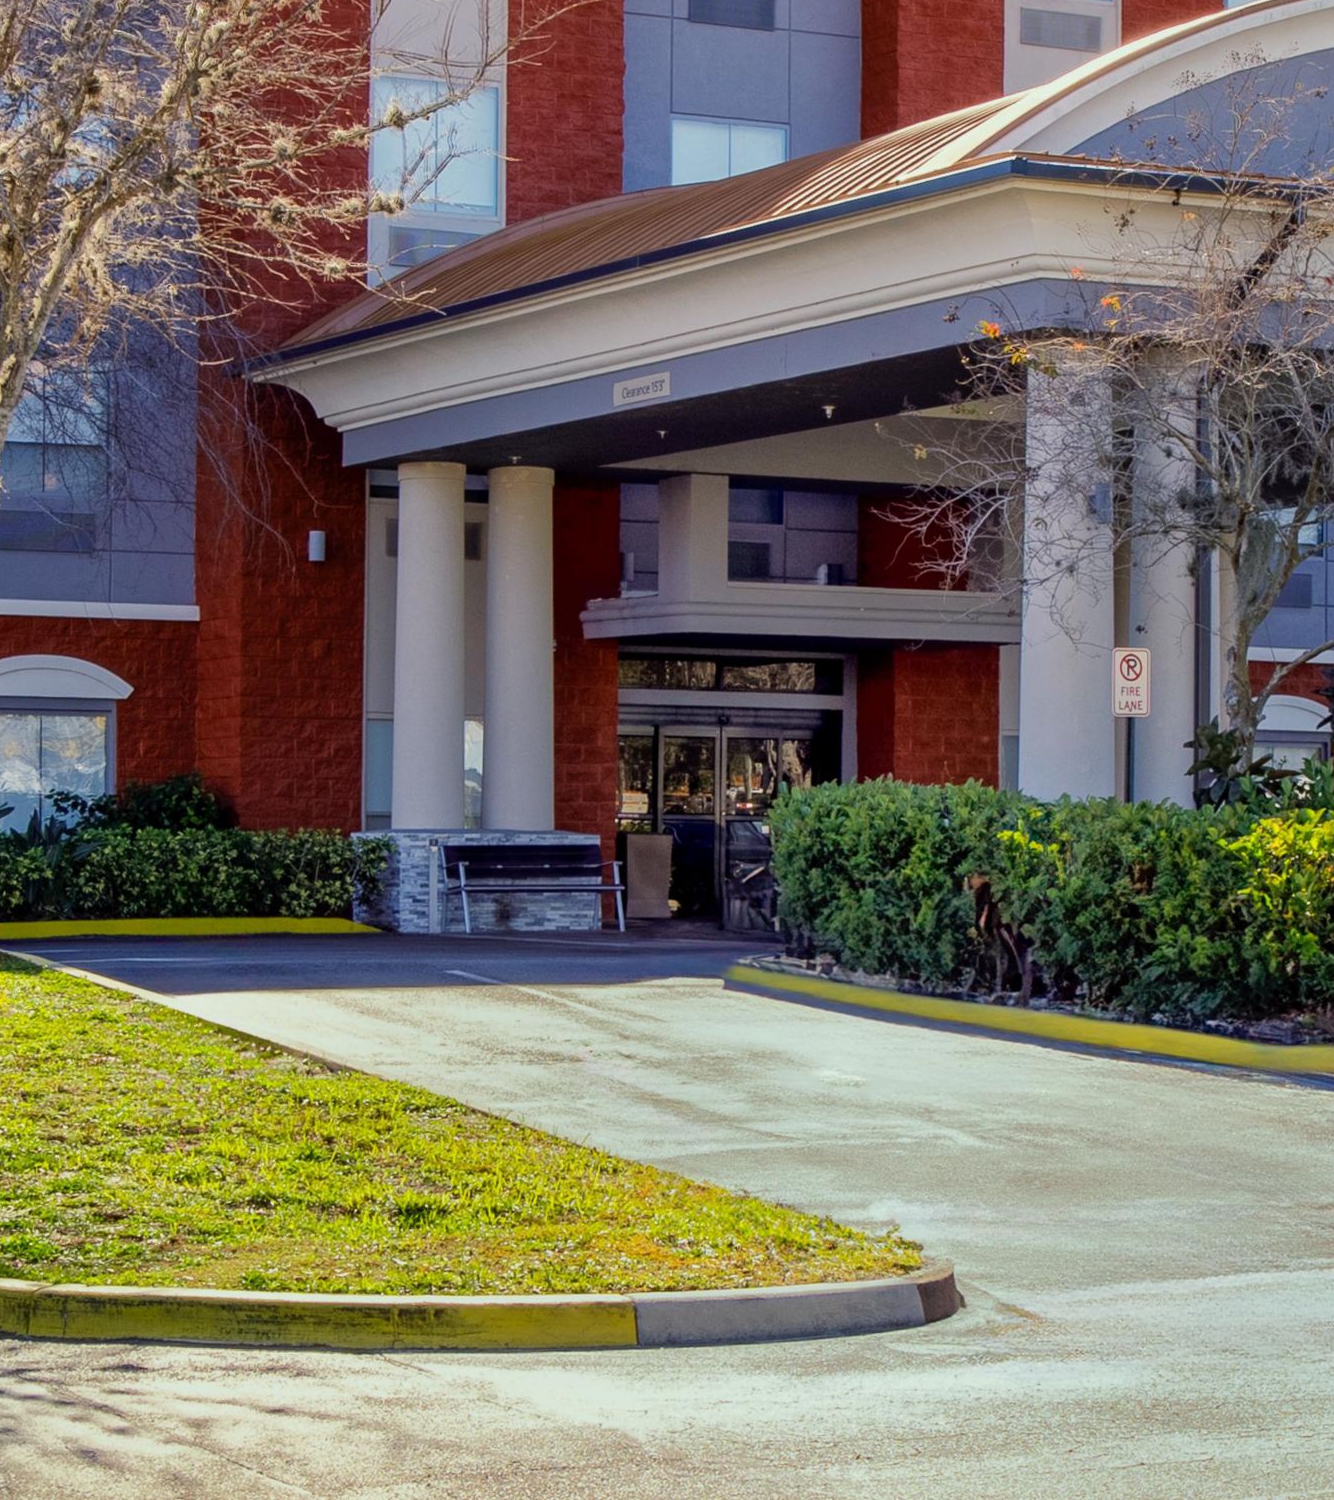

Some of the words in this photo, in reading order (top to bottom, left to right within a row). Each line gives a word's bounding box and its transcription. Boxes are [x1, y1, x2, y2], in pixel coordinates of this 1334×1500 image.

[621, 384, 650, 399] Clearance
[1120, 686, 1142, 696] FIRE
[1118, 700, 1143, 711] LANE
